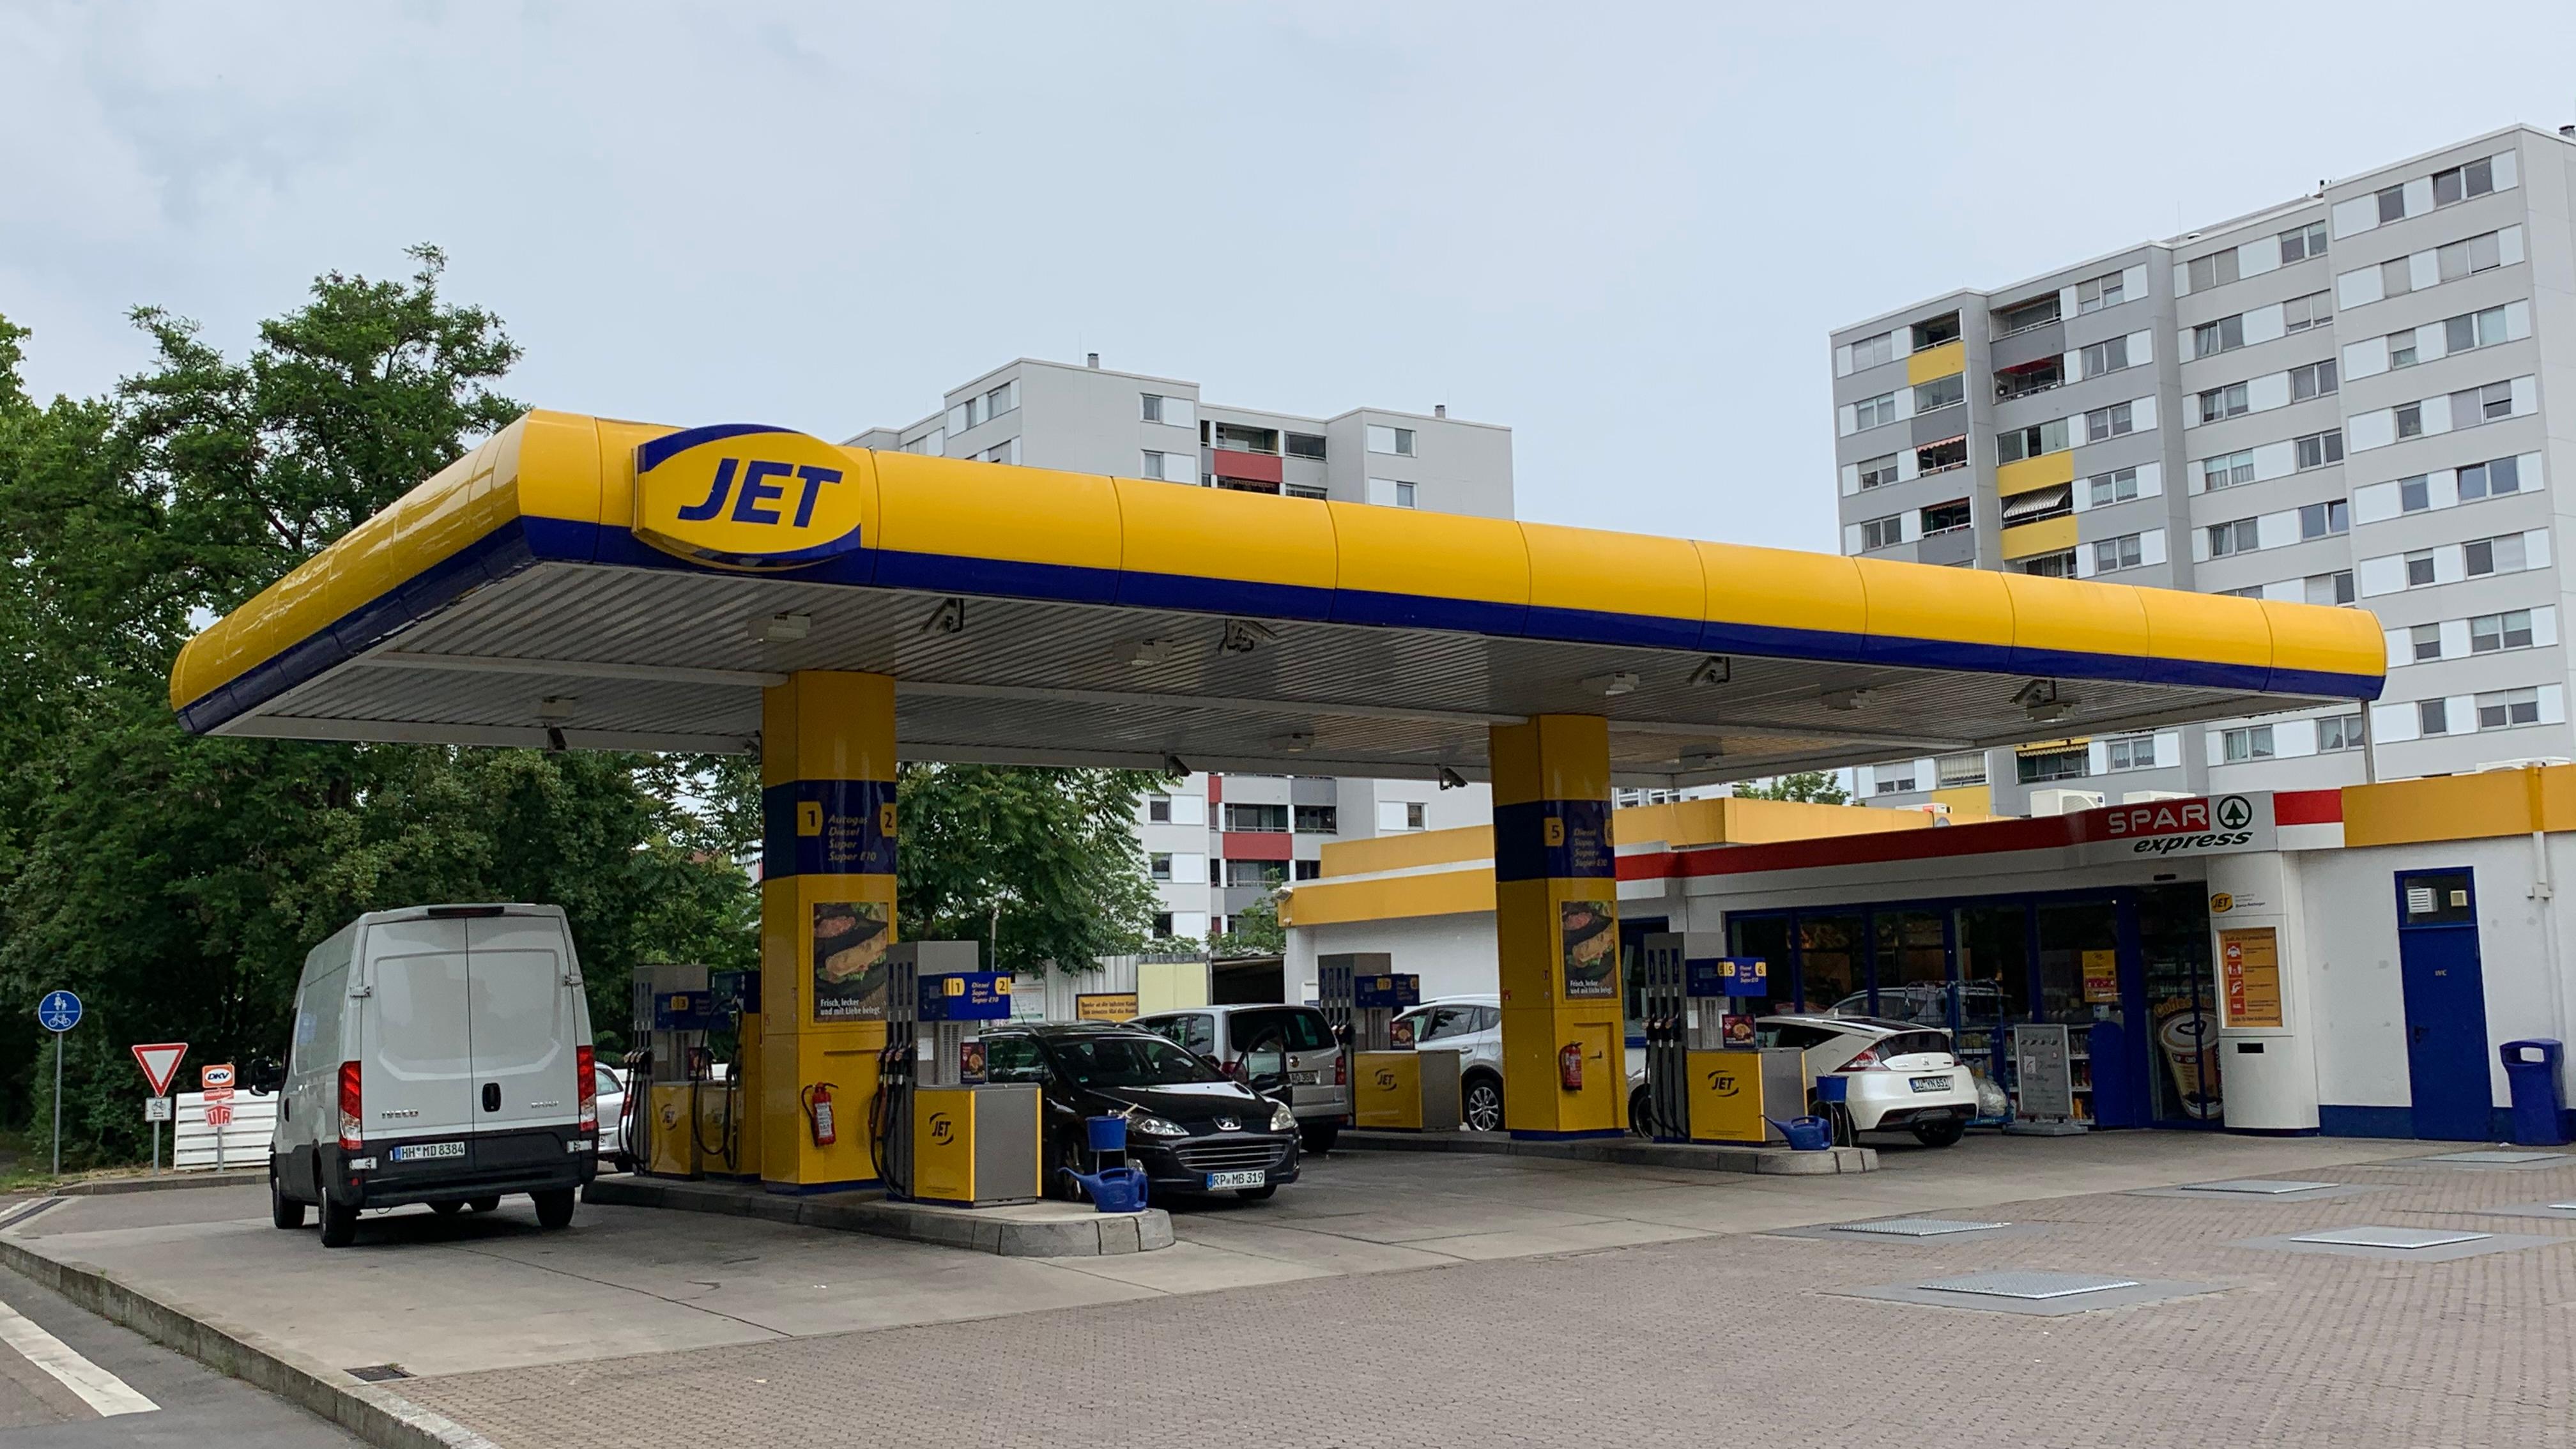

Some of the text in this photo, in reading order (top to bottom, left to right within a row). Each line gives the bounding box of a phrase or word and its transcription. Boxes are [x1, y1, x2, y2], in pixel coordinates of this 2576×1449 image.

[677, 457, 843, 528] JET
[808, 810, 816, 827] 1
[828, 814, 868, 827] Autogas
[884, 811, 893, 828] 2
[2108, 804, 2207, 834] SPAR
[829, 827, 860, 836] Diesel
[1552, 825, 1560, 839] 5
[829, 838, 857, 851] Super
[1574, 838, 1595, 848] Super
[2133, 831, 2254, 855] express
[828, 852, 877, 863] Super E10
[1574, 859, 1596, 868] Super
[2212, 897, 2230, 908] JET
[1728, 965, 1734, 974] 5
[1758, 965, 1764, 974] 6
[955, 982, 960, 993] 1
[999, 981, 1006, 992] 2
[820, 998, 859, 1008] Frisch, lecker
[2154, 997, 2193, 1018] Coffee
[820, 1007, 833, 1015] und
[1377, 1074, 1395, 1085] JET
[1712, 1077, 1736, 1090] JET
[207, 1106, 231, 1126] UTA
[382, 1109, 419, 1118] IVECO
[931, 1121, 952, 1137] JET
[401, 1144, 464, 1159] HH MD 8384
[1213, 1172, 1264, 1186] RP MB 319
